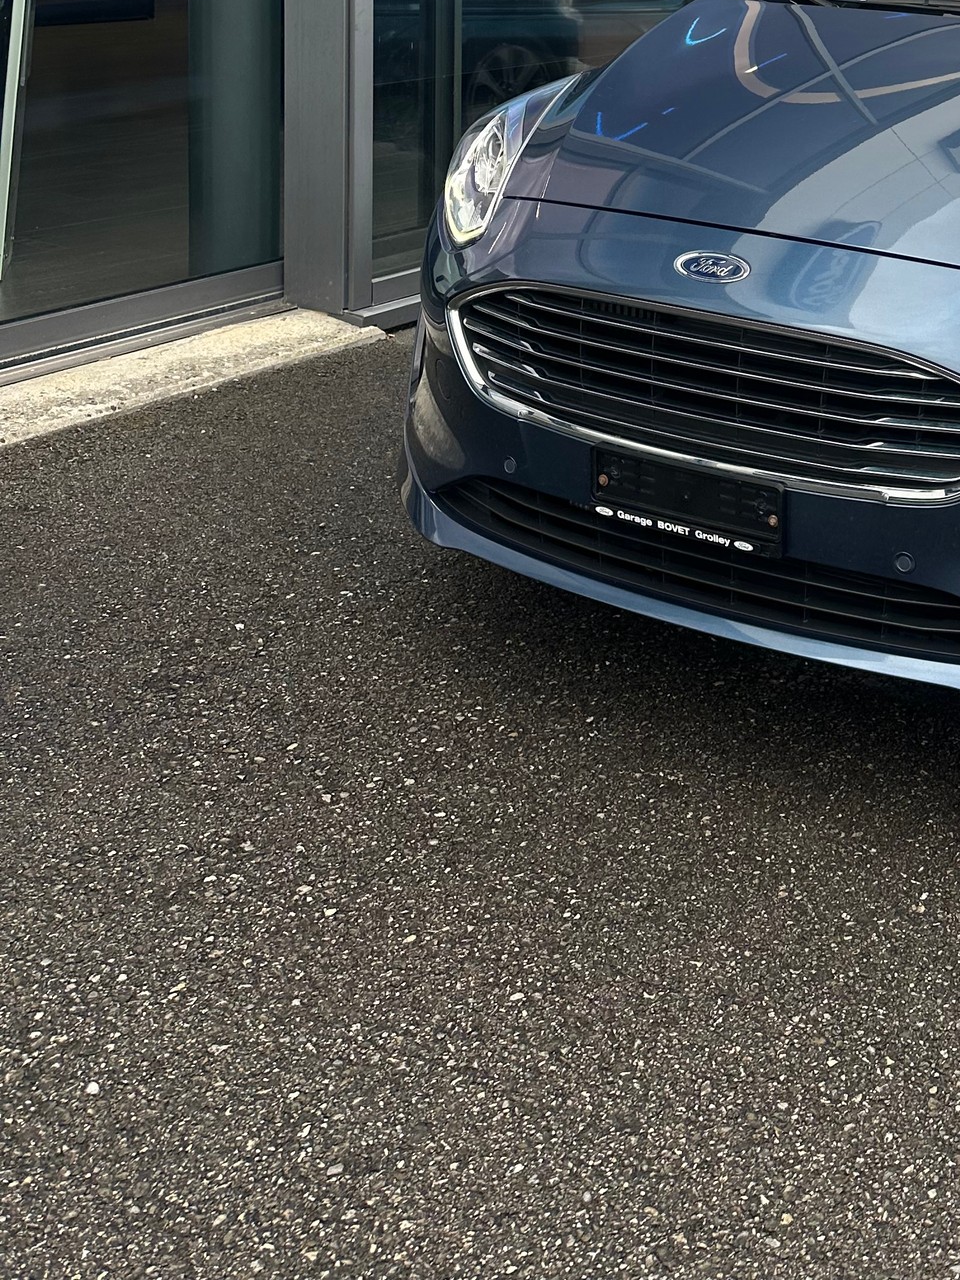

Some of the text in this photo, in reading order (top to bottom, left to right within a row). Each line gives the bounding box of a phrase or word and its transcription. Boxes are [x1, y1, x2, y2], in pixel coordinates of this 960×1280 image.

[690, 257, 734, 277] Ford
[616, 509, 653, 527] Garage
[657, 520, 690, 536] BOVET
[694, 530, 731, 547] Grolley
